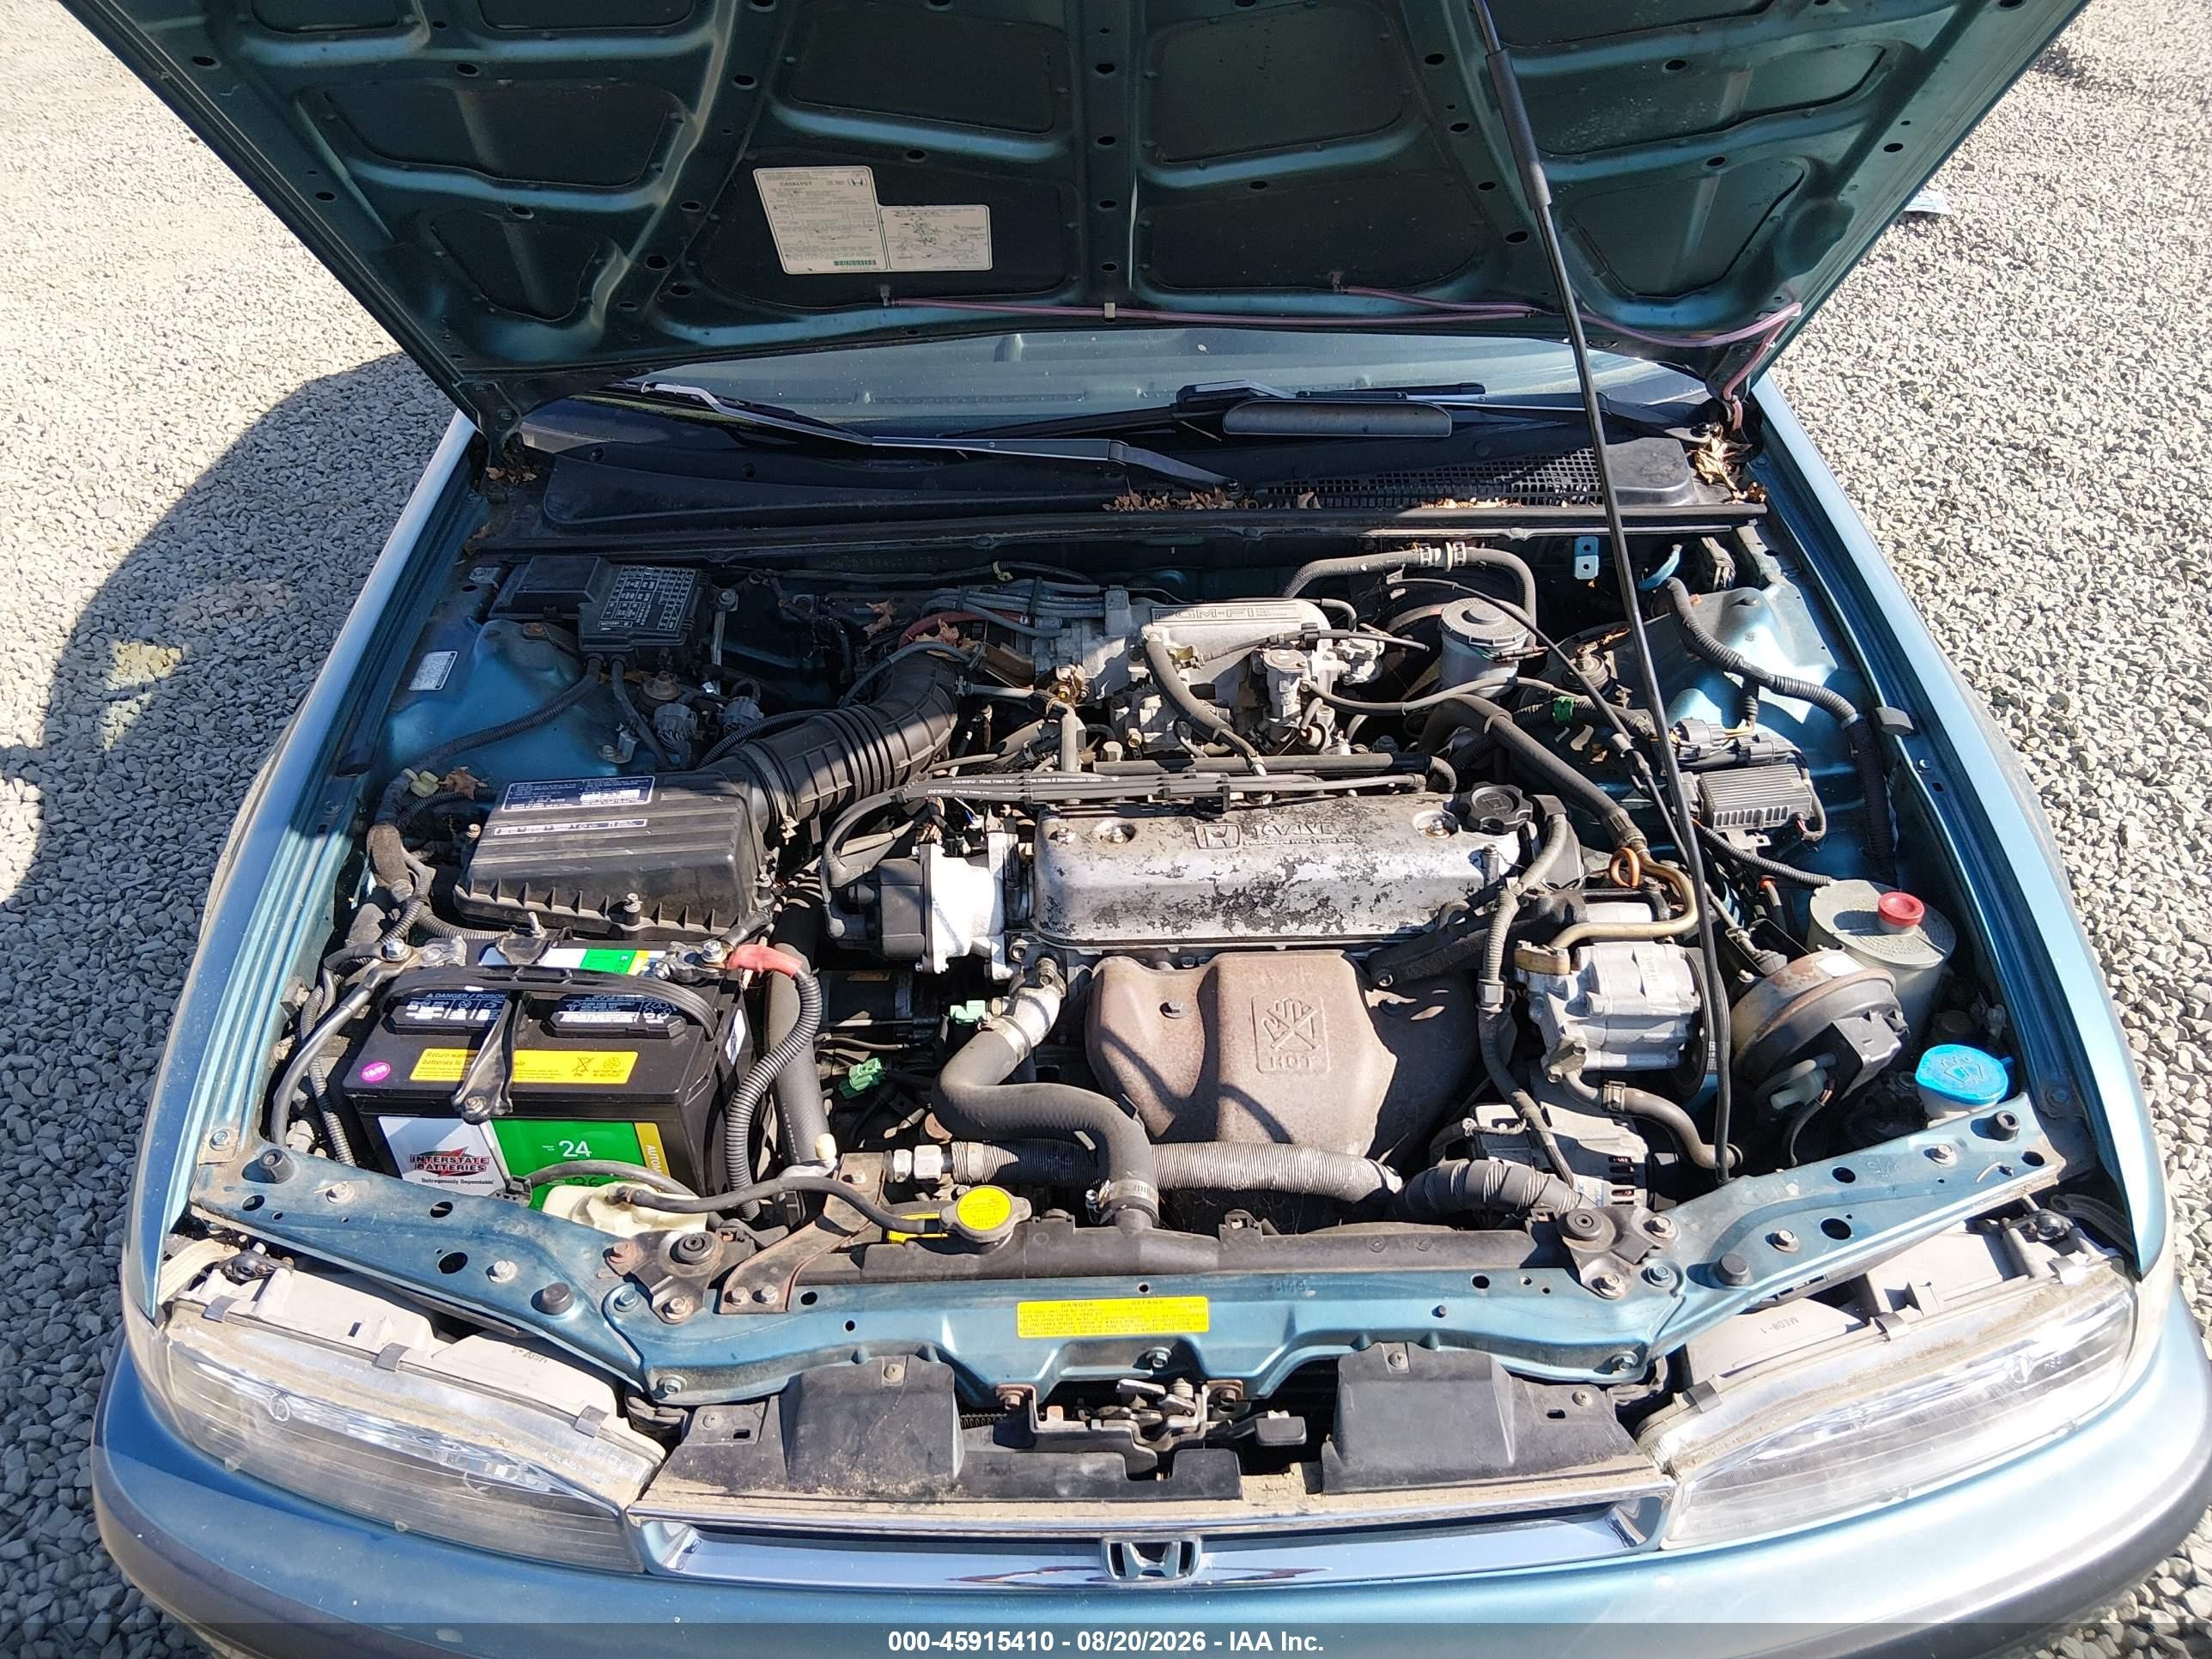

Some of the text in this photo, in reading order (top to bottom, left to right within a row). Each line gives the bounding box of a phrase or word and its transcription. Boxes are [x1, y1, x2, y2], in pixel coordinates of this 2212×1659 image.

[1154, 607, 1255, 620] PGM-FI
[558, 1140, 592, 1158] 24
[411, 1156, 489, 1164] INTERSTATE
